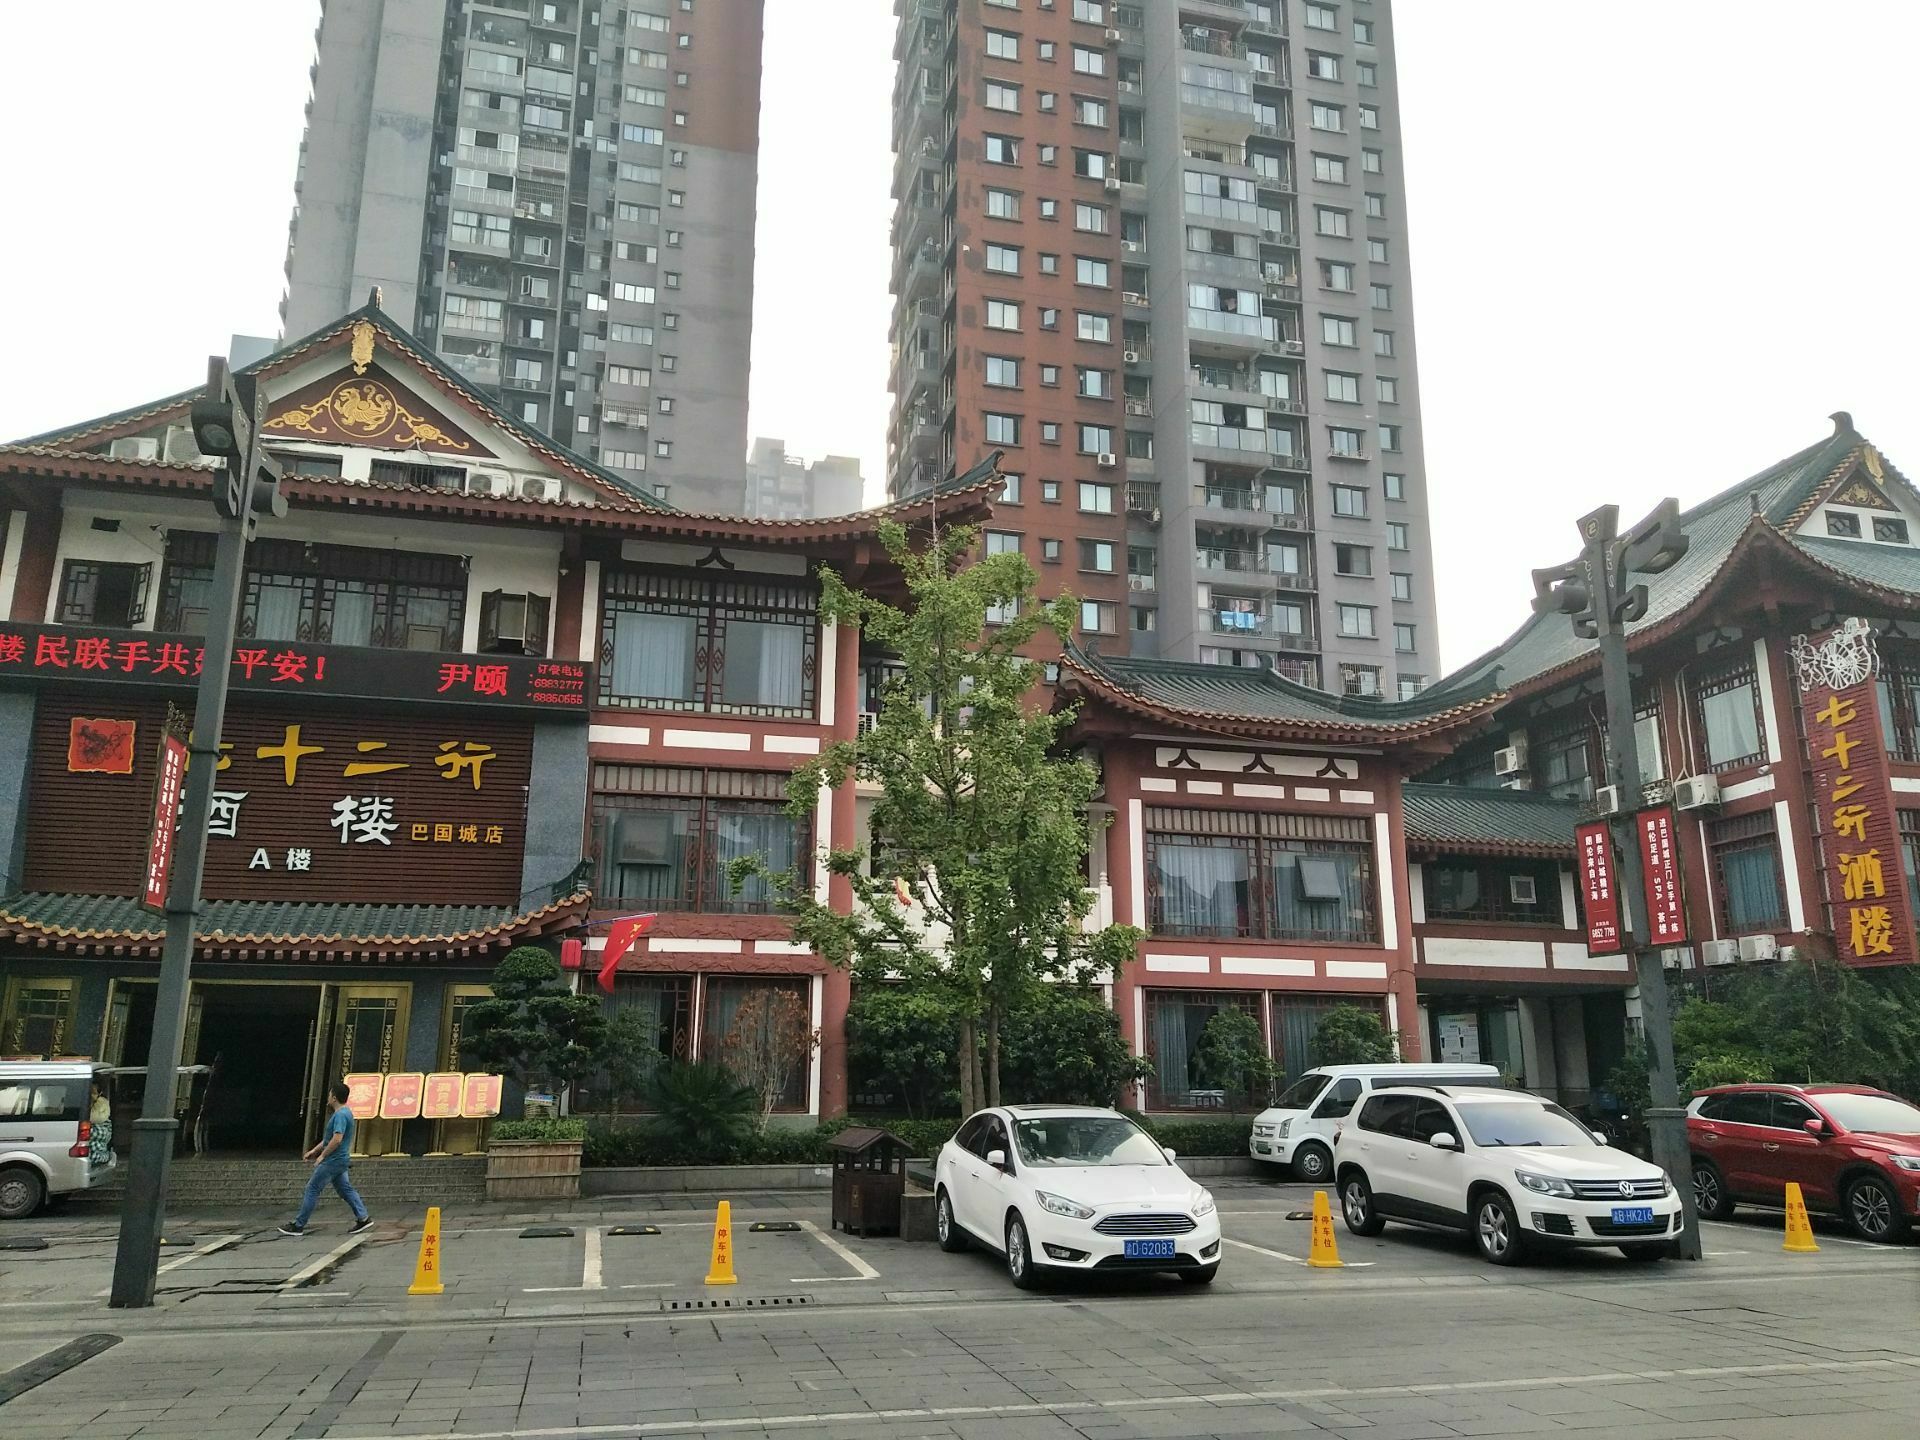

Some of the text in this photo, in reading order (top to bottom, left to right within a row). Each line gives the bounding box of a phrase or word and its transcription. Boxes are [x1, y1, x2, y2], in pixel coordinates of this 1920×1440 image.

[410, 823, 504, 844] 巴国城店
[1816, 695, 1894, 957] 七十二行酒楼
[423, 1234, 437, 1271] 停车位
[717, 1229, 728, 1264] 停车位
